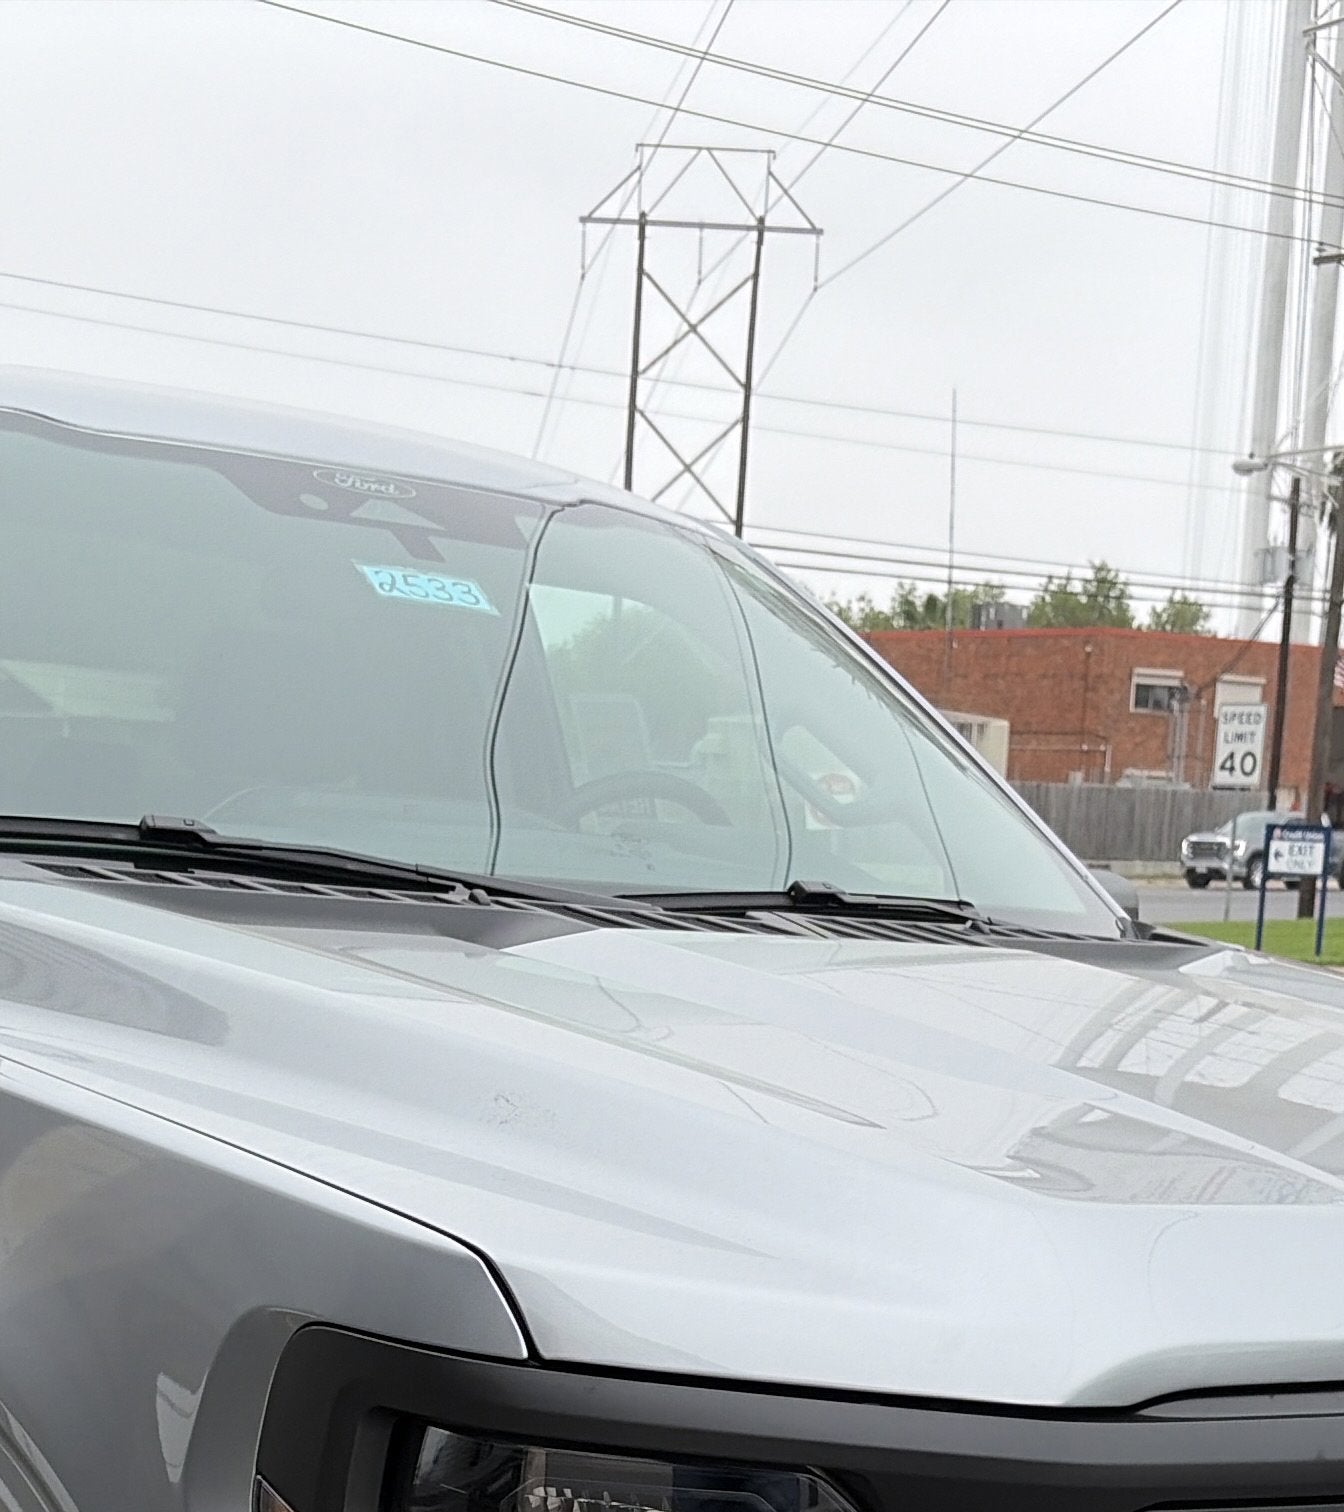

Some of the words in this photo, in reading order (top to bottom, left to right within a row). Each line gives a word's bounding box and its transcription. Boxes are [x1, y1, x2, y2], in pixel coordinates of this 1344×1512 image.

[374, 570, 481, 606] 2533
[1221, 711, 1262, 726] SPEED
[1223, 731, 1257, 745] LIMIT
[1219, 751, 1258, 777] 40
[1288, 843, 1315, 857] EXIT
